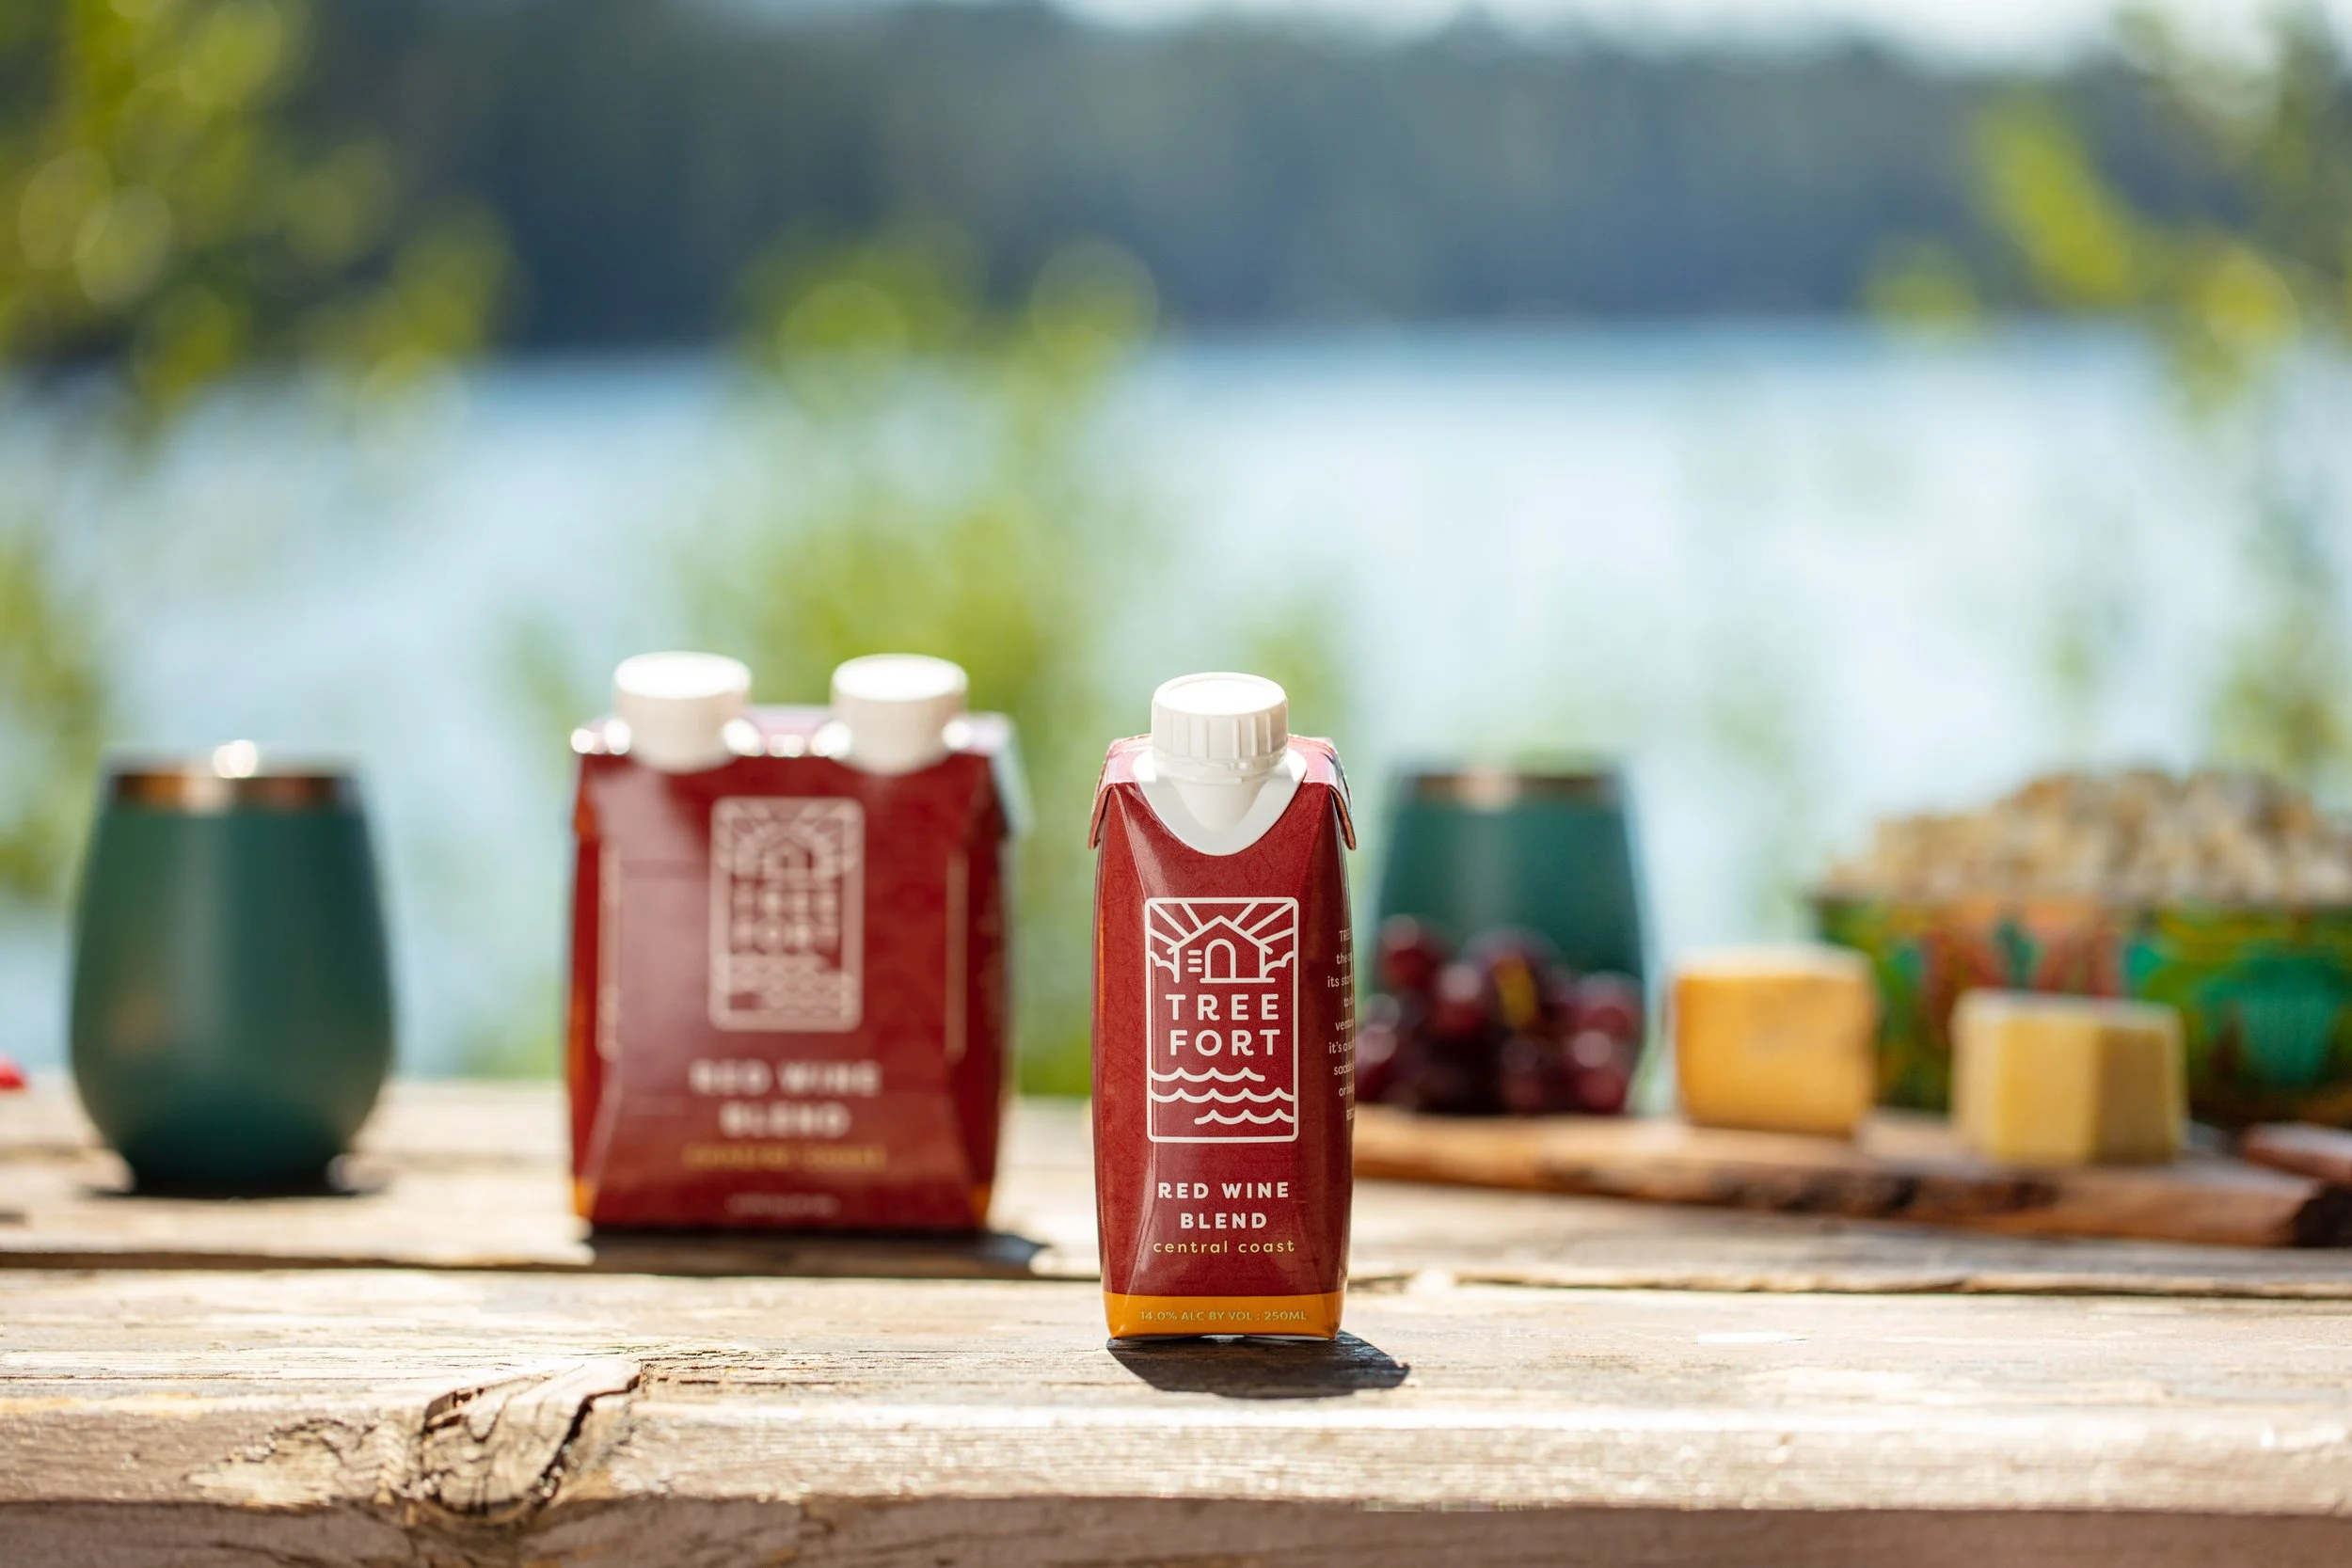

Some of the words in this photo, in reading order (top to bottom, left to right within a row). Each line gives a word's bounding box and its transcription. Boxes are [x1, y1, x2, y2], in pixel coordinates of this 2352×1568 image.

[1327, 975, 1340, 988] its
[1165, 993, 1279, 1021] TREE
[1169, 1029, 1280, 1056] FORT
[1328, 1041, 1342, 1053] it's
[1157, 1182, 1209, 1199] RED
[1221, 1181, 1290, 1198] WINE
[1180, 1212, 1267, 1229] BLEND
[1152, 1241, 1228, 1254] central
[1238, 1240, 1295, 1254] coast
[1139, 1311, 1178, 1322] 14.0%
[1181, 1311, 1205, 1322] ALC
[1209, 1311, 1225, 1322] BY
[1228, 1311, 1253, 1322] VOL
[1263, 1310, 1308, 1322] 250ML
